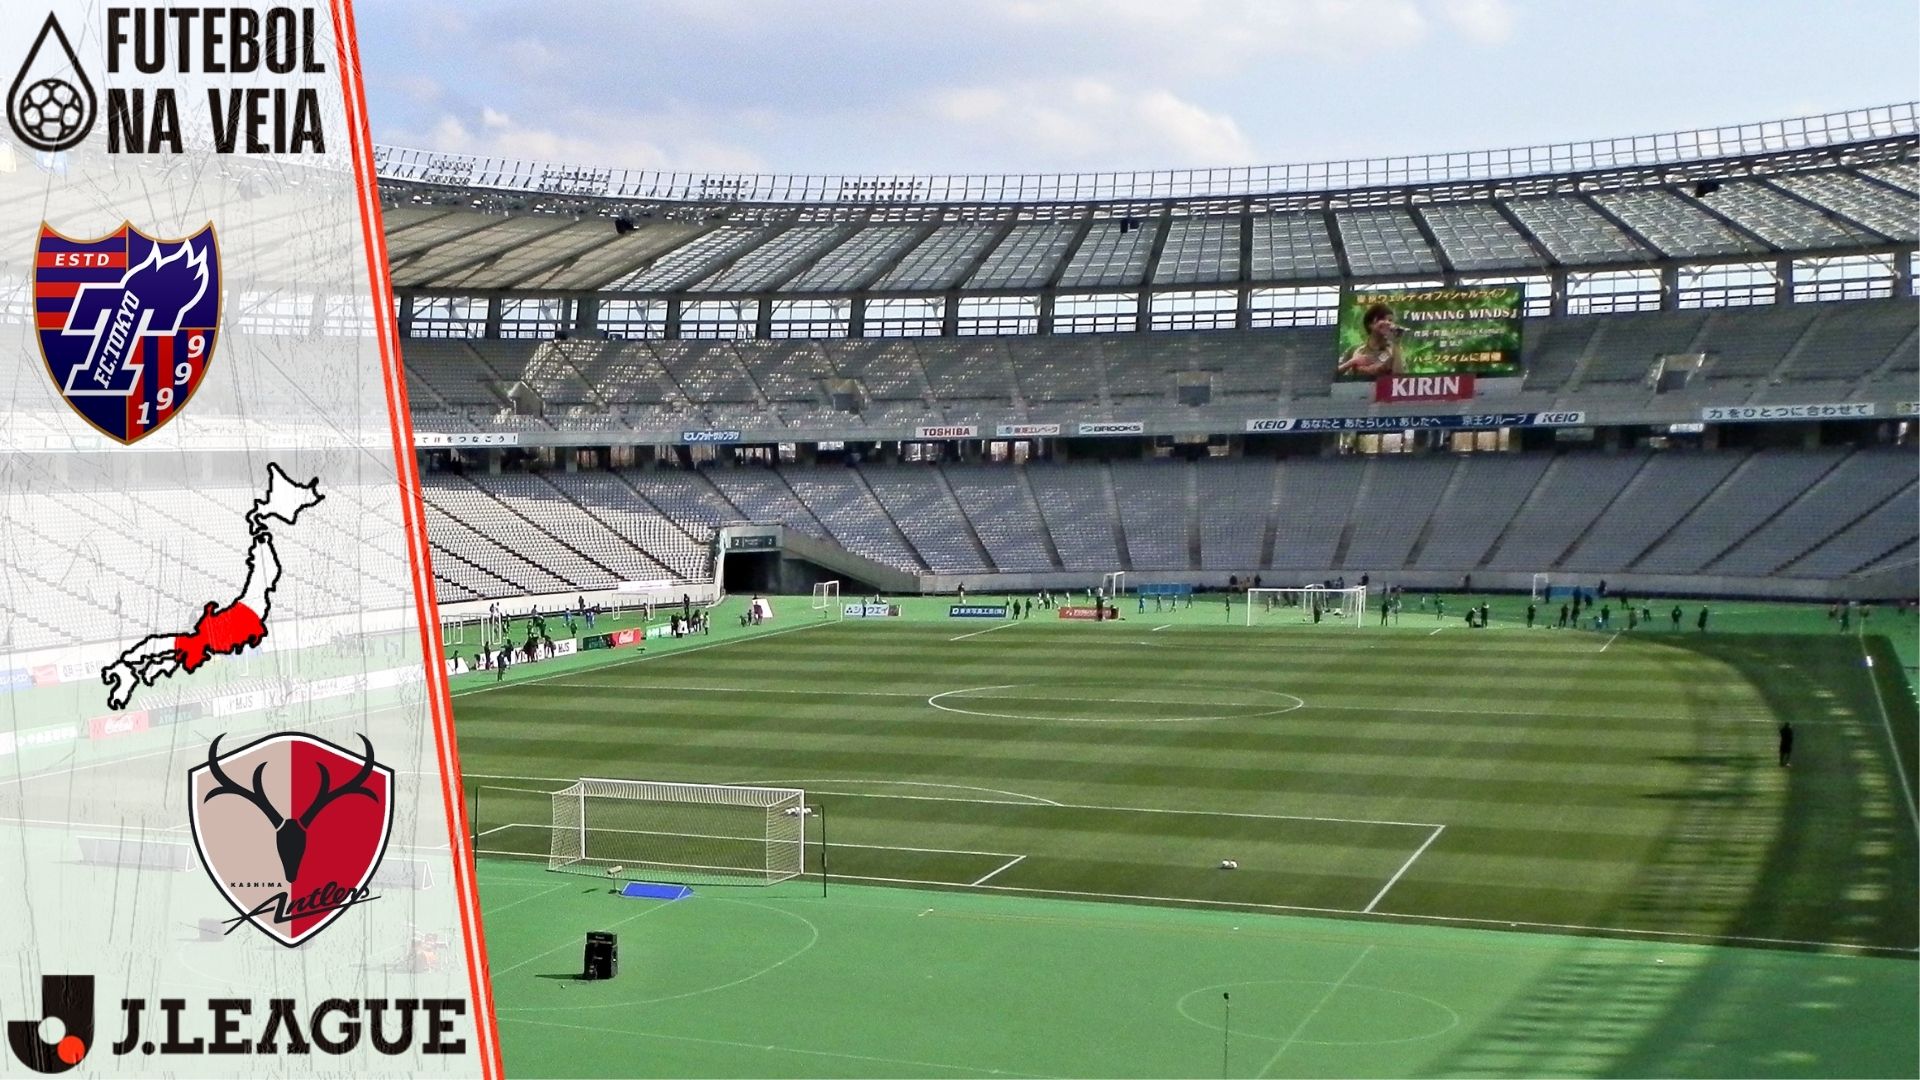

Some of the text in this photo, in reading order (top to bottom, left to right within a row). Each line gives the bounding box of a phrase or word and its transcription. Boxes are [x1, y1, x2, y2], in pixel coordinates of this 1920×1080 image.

[1391, 376, 1460, 397] KIRIN
[1542, 412, 1579, 423] KEIO
[1708, 404, 1868, 419] 力をひとつに合わせて
[1252, 420, 1288, 430] KEIO
[1301, 416, 1441, 429] あなたと あたらしい あしたへ
[922, 428, 970, 437] TOSHIBA
